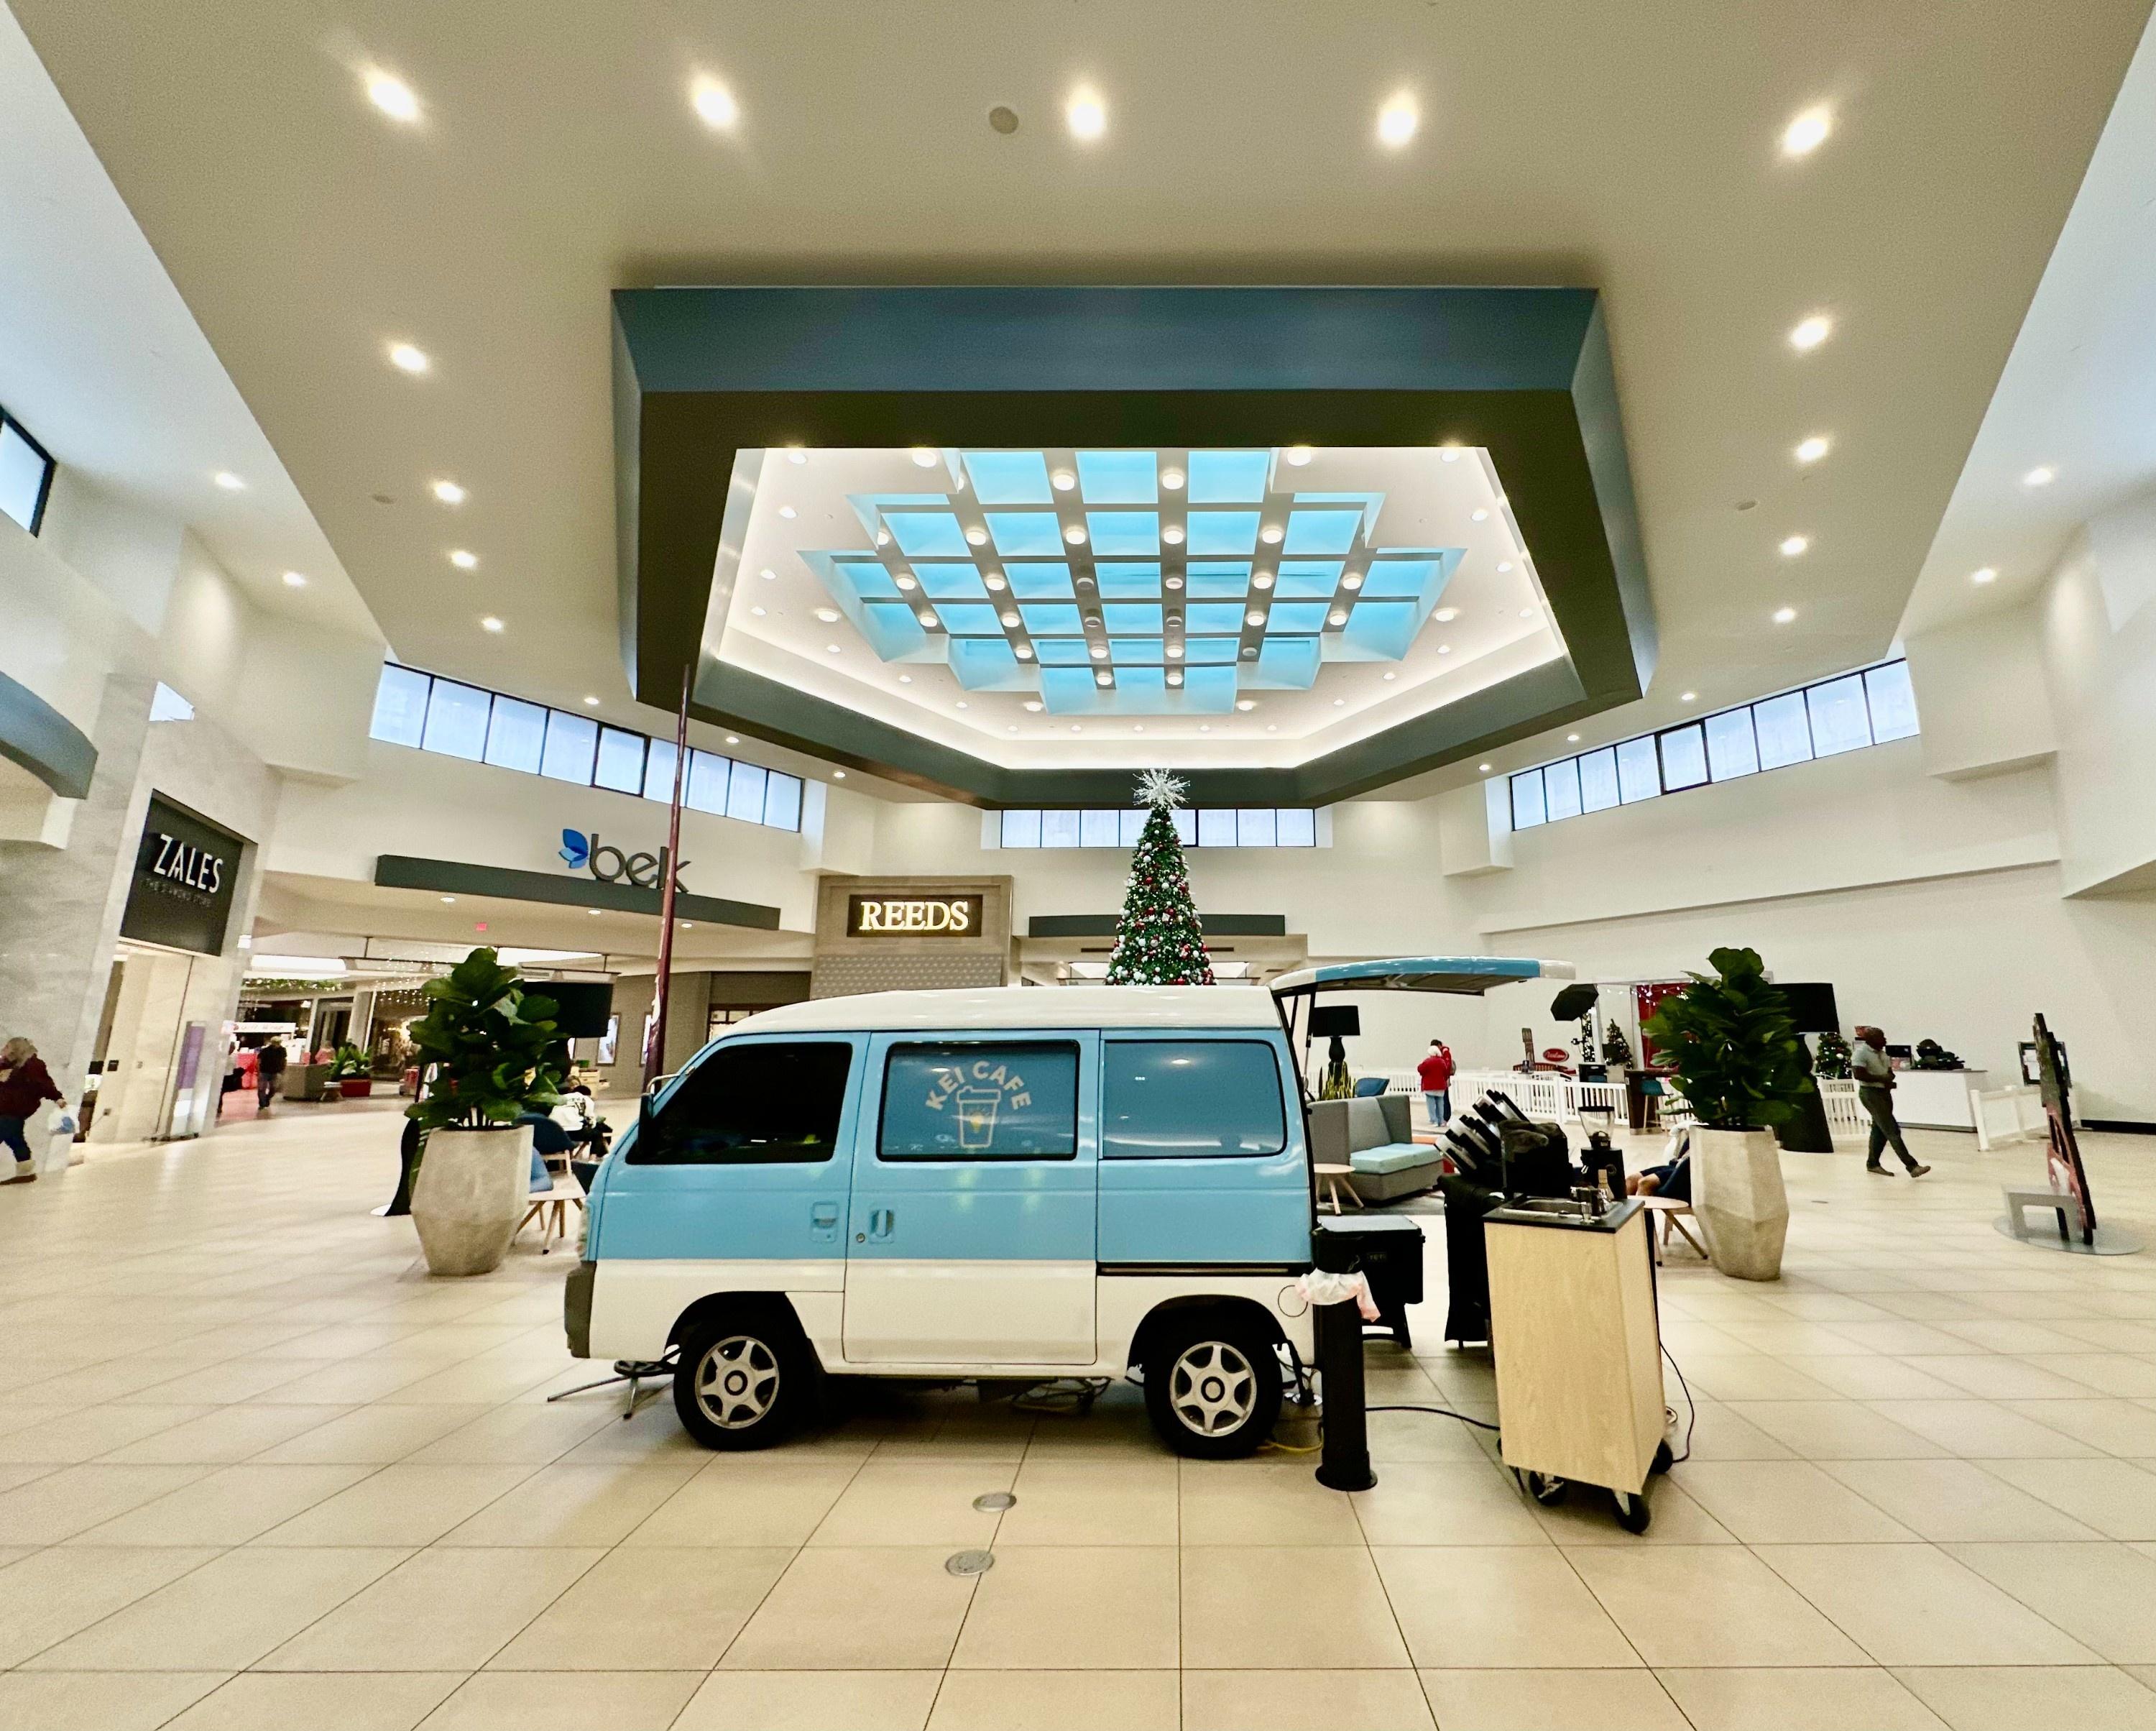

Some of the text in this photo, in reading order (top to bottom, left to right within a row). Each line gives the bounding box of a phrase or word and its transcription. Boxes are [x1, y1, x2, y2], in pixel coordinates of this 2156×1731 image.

[154, 834, 224, 894] ZALES
[859, 901, 969, 931] REEDS
[926, 1060, 1032, 1111] KEI CAFE
